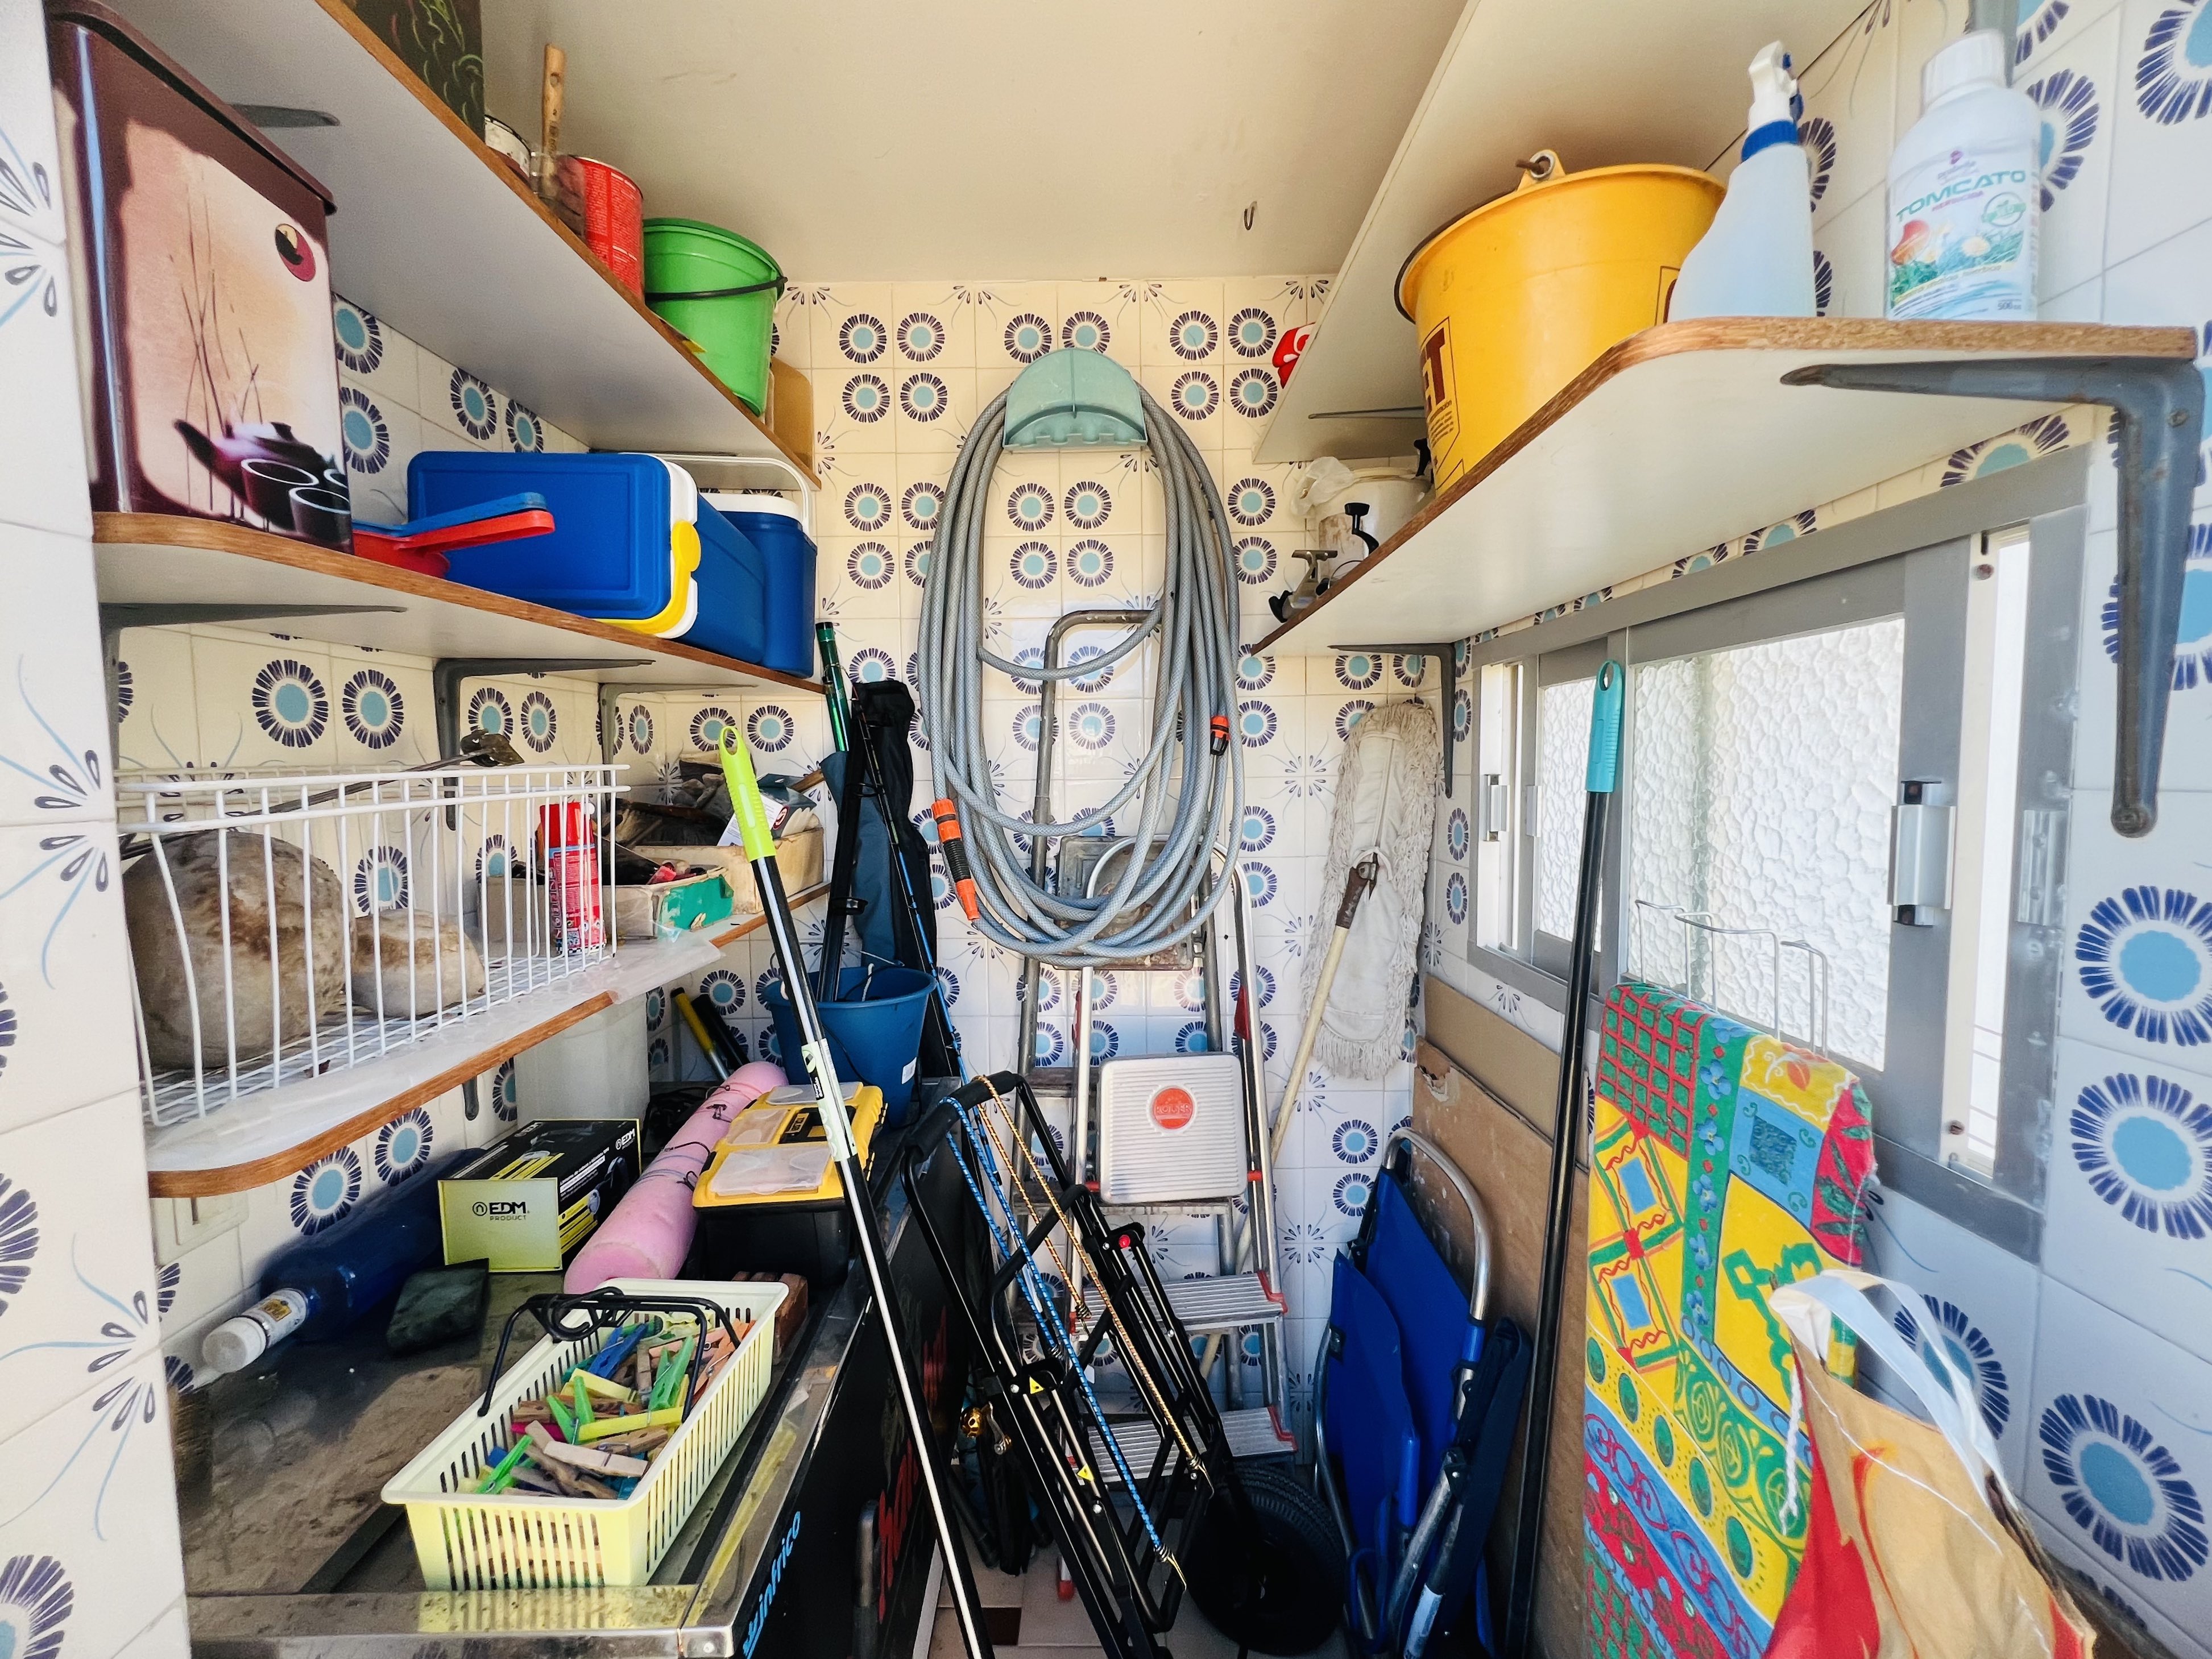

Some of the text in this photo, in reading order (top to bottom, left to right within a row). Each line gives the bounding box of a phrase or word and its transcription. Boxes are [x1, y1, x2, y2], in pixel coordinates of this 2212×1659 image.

[1896, 170, 2026, 222] TOMCATO
[621, 1127, 636, 1146] EDM
[489, 1201, 527, 1215] EDM
